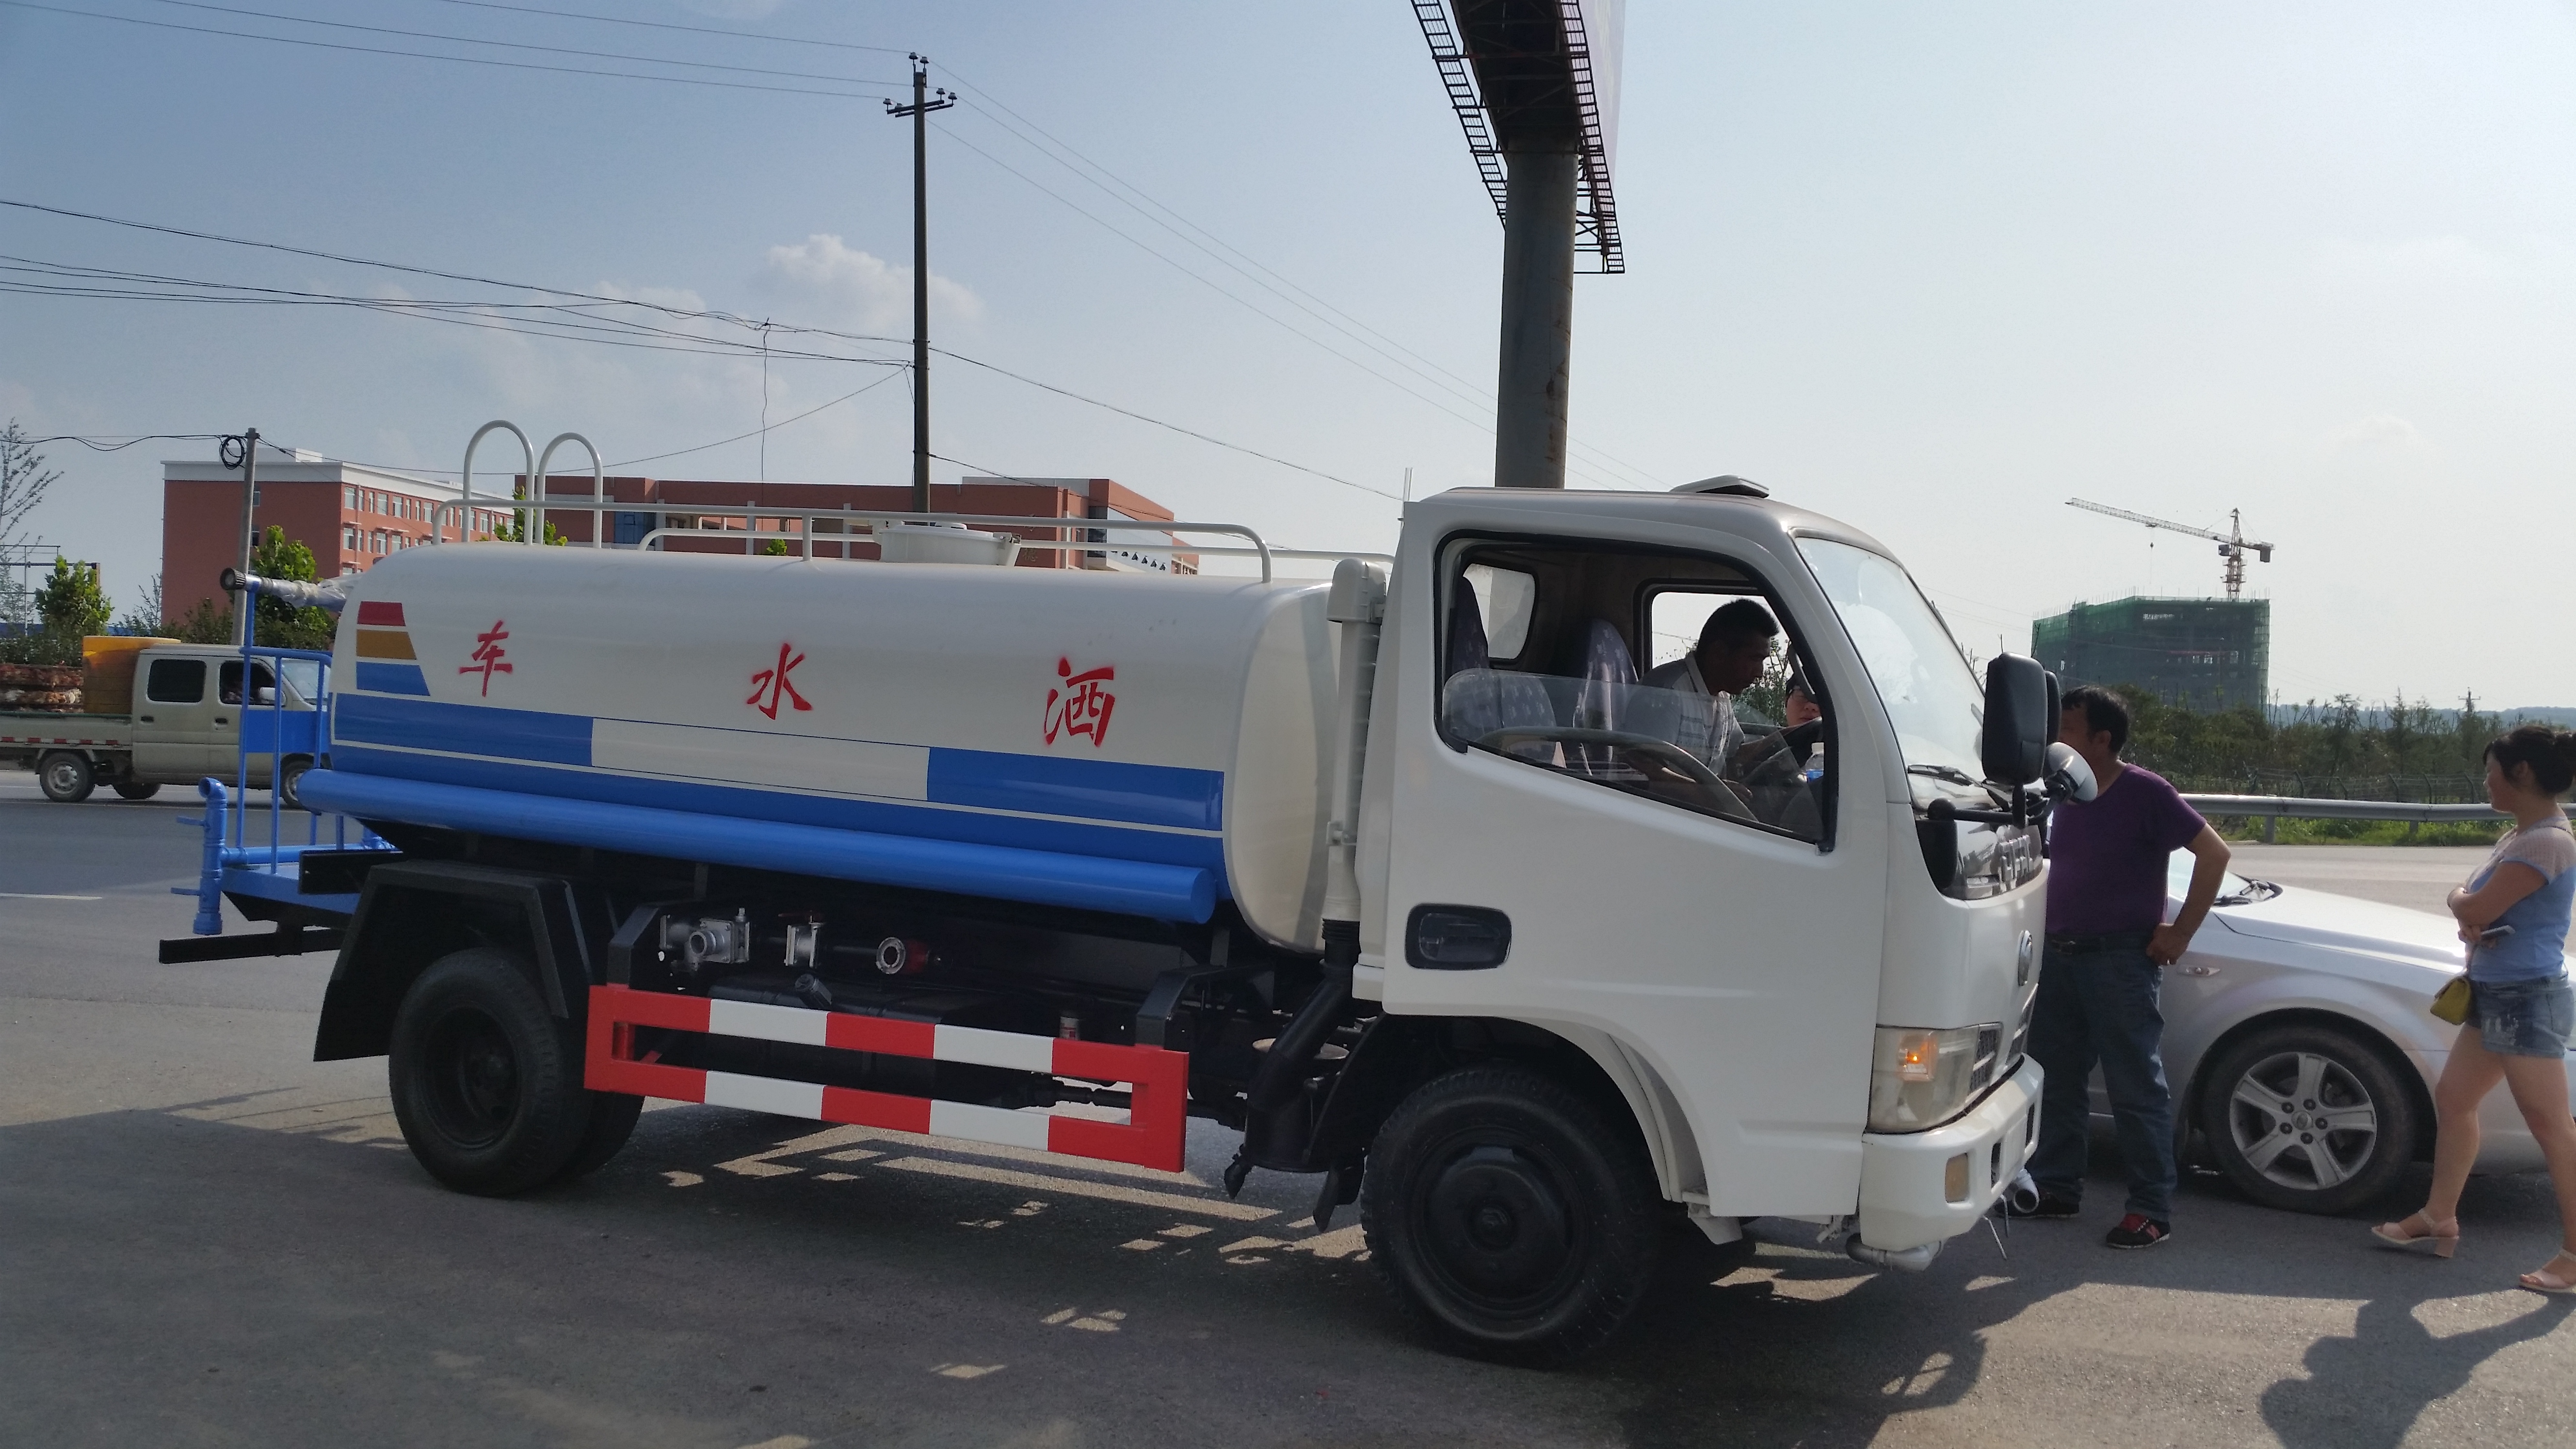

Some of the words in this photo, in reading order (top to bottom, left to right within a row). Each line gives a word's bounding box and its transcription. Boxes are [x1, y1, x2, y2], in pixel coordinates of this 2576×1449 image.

[459, 621, 513, 697] 车
[747, 643, 812, 720] 水
[1044, 656, 1115, 747] 洒
